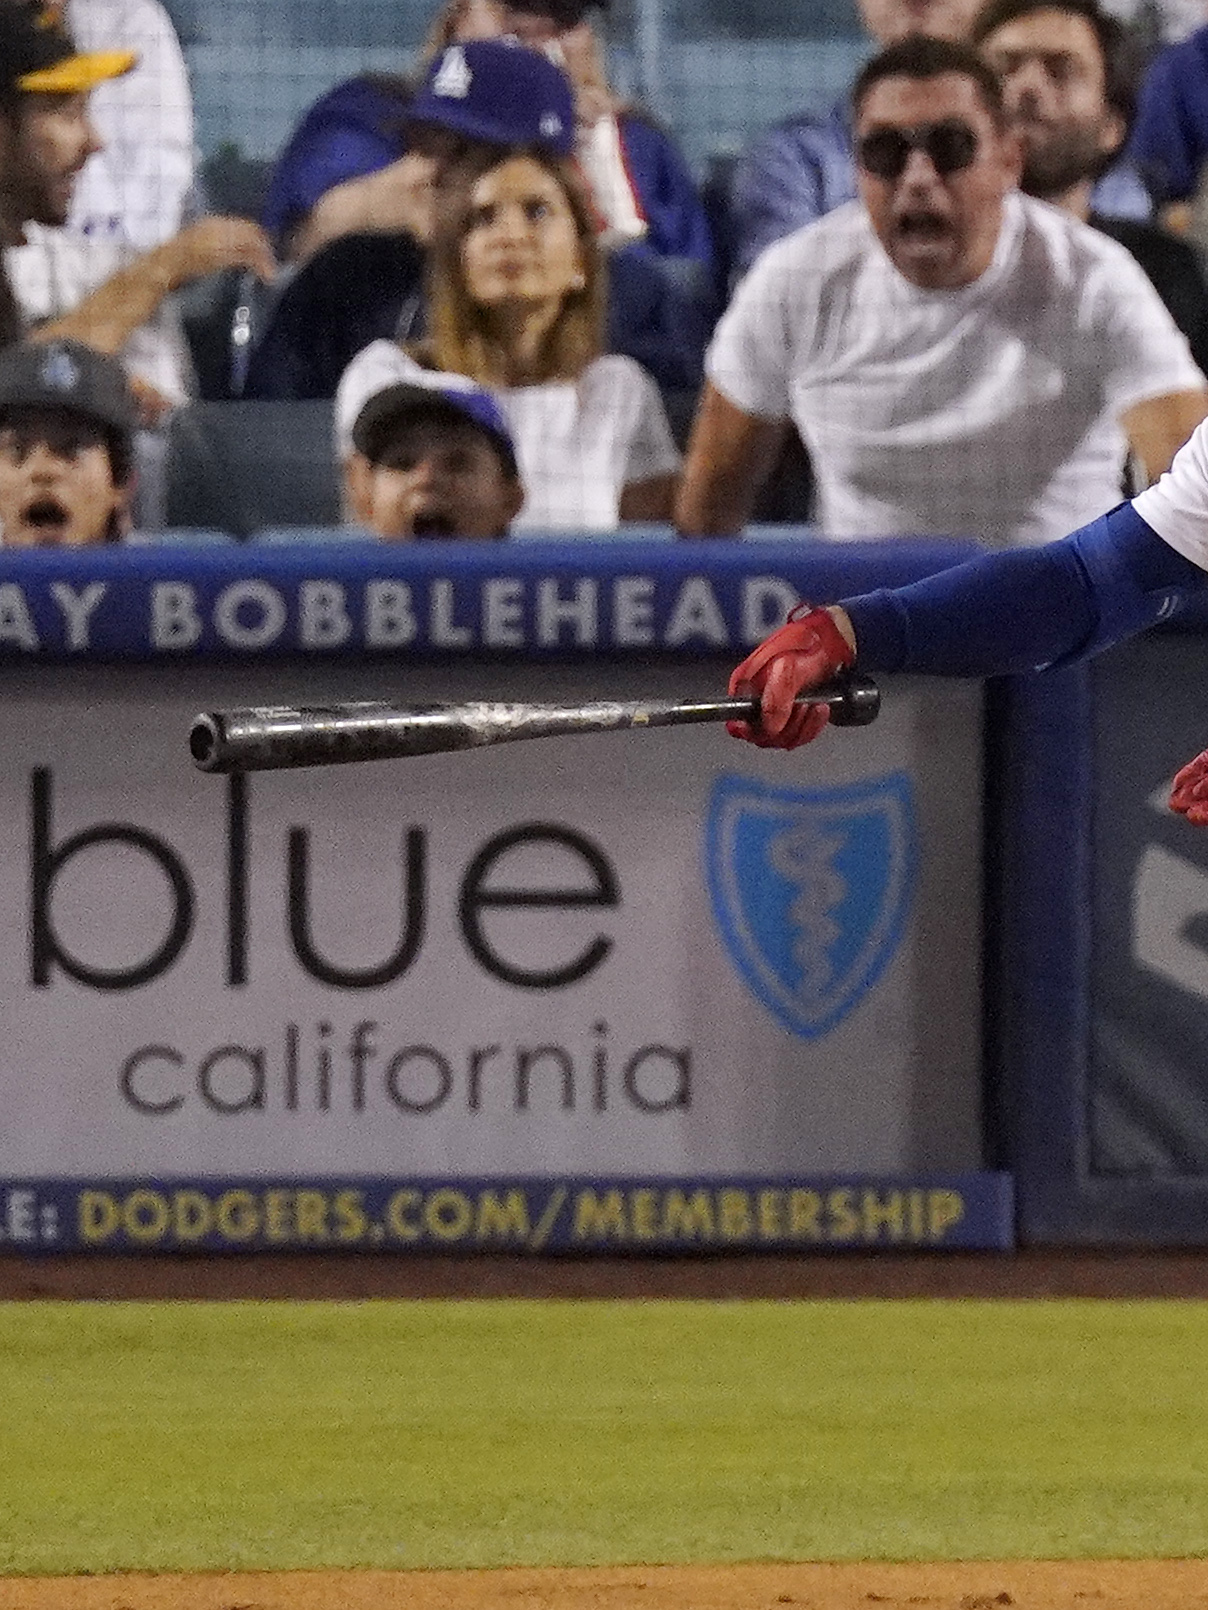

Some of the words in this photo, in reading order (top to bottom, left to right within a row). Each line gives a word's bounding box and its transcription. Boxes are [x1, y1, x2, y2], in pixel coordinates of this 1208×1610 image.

[150, 575, 800, 652] BOBBLEHEAD
[30, 765, 622, 993] blue
[119, 1021, 692, 1115] california
[0, 1190, 60, 1241] E:
[79, 1187, 965, 1248] DODGERS.COM/MEMBERSHIP
